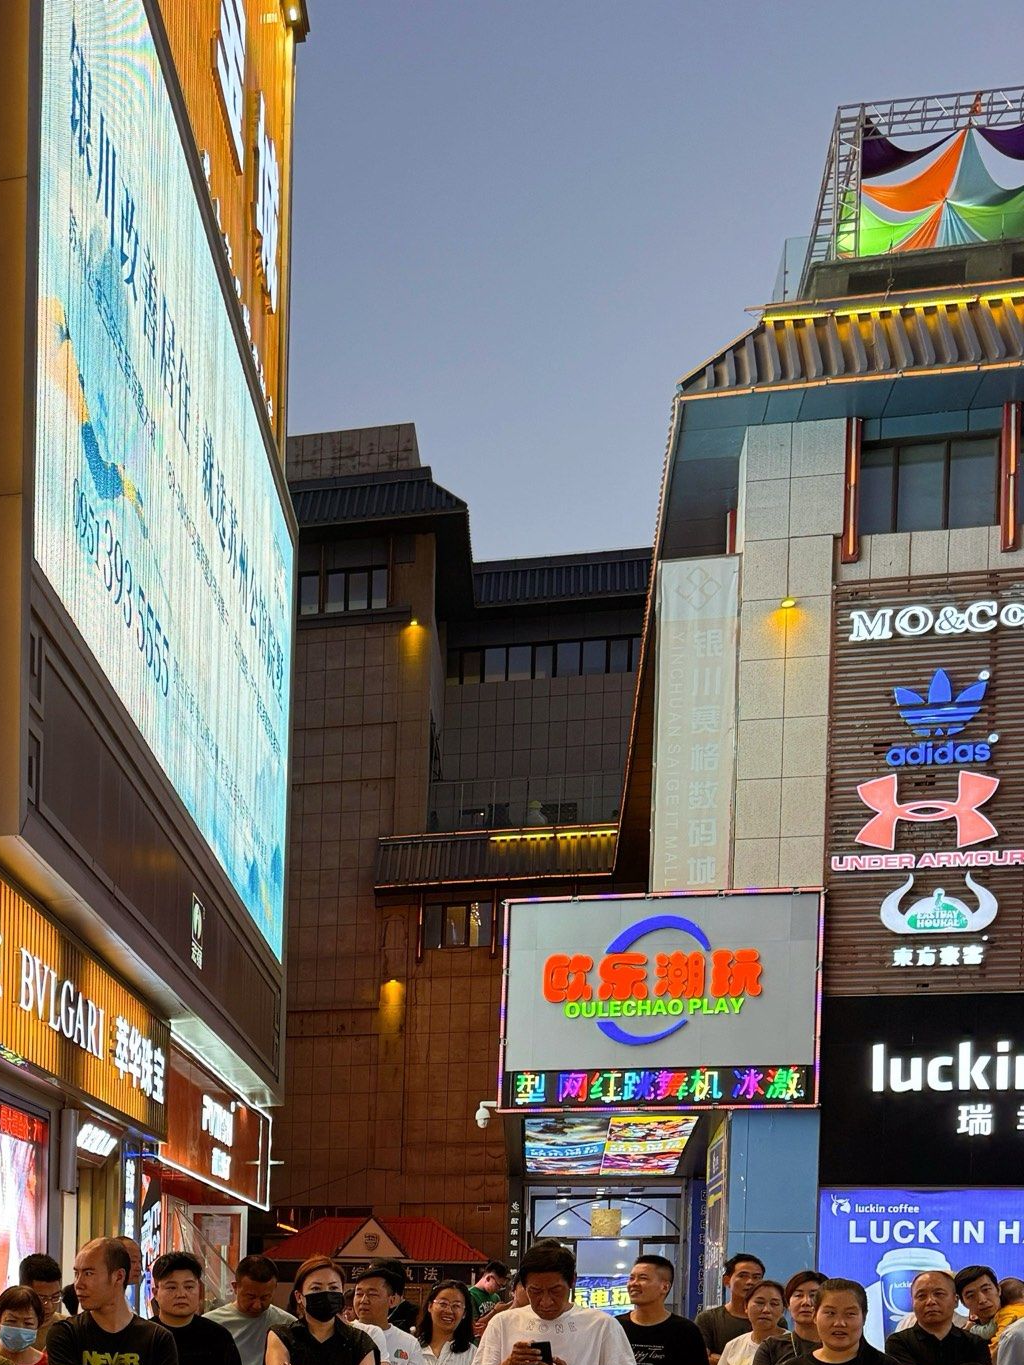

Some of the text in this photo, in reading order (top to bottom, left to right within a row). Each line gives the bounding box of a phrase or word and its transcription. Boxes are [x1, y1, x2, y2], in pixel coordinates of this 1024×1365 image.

[69, 18, 191, 455] 银川改善居住
[103, 519, 133, 628] 393
[137, 584, 169, 698] 5555
[667, 631, 685, 738] YINCHUAN
[666, 743, 681, 809] SAIGE
[686, 628, 724, 886] 银川赛格数码城
[885, 739, 991, 767] adidas
[663, 835, 678, 887] MALL
[831, 850, 1024, 871] UNDER ARMOUR
[543, 949, 763, 1003] 欧乐潮玩
[19, 947, 104, 1060] BVLGARI
[115, 1015, 165, 1104] 萃华珠宝
[564, 996, 746, 1019] OULECHAO PLAY
[515, 1066, 805, 1103] 型 网红跳舞机 冰激
[849, 1219, 1024, 1244] LUCK IN H
[855, 1203, 919, 1214] luckin coffee
